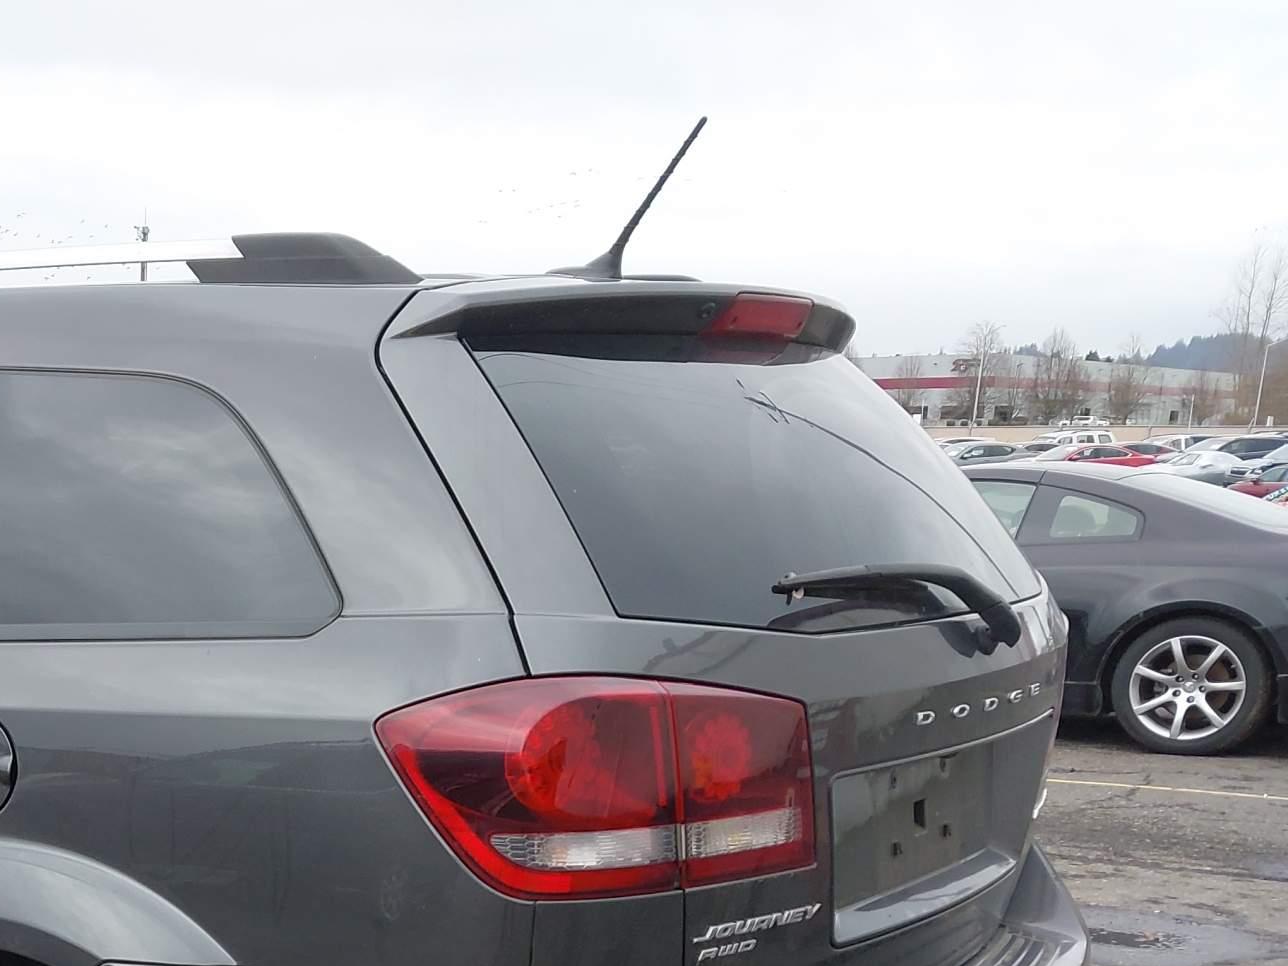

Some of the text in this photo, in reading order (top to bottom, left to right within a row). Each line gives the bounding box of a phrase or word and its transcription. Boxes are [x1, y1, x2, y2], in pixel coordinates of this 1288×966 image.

[916, 683, 1041, 725] DODGE
[693, 903, 822, 943] JOURNEY
[697, 939, 758, 962] AWD
